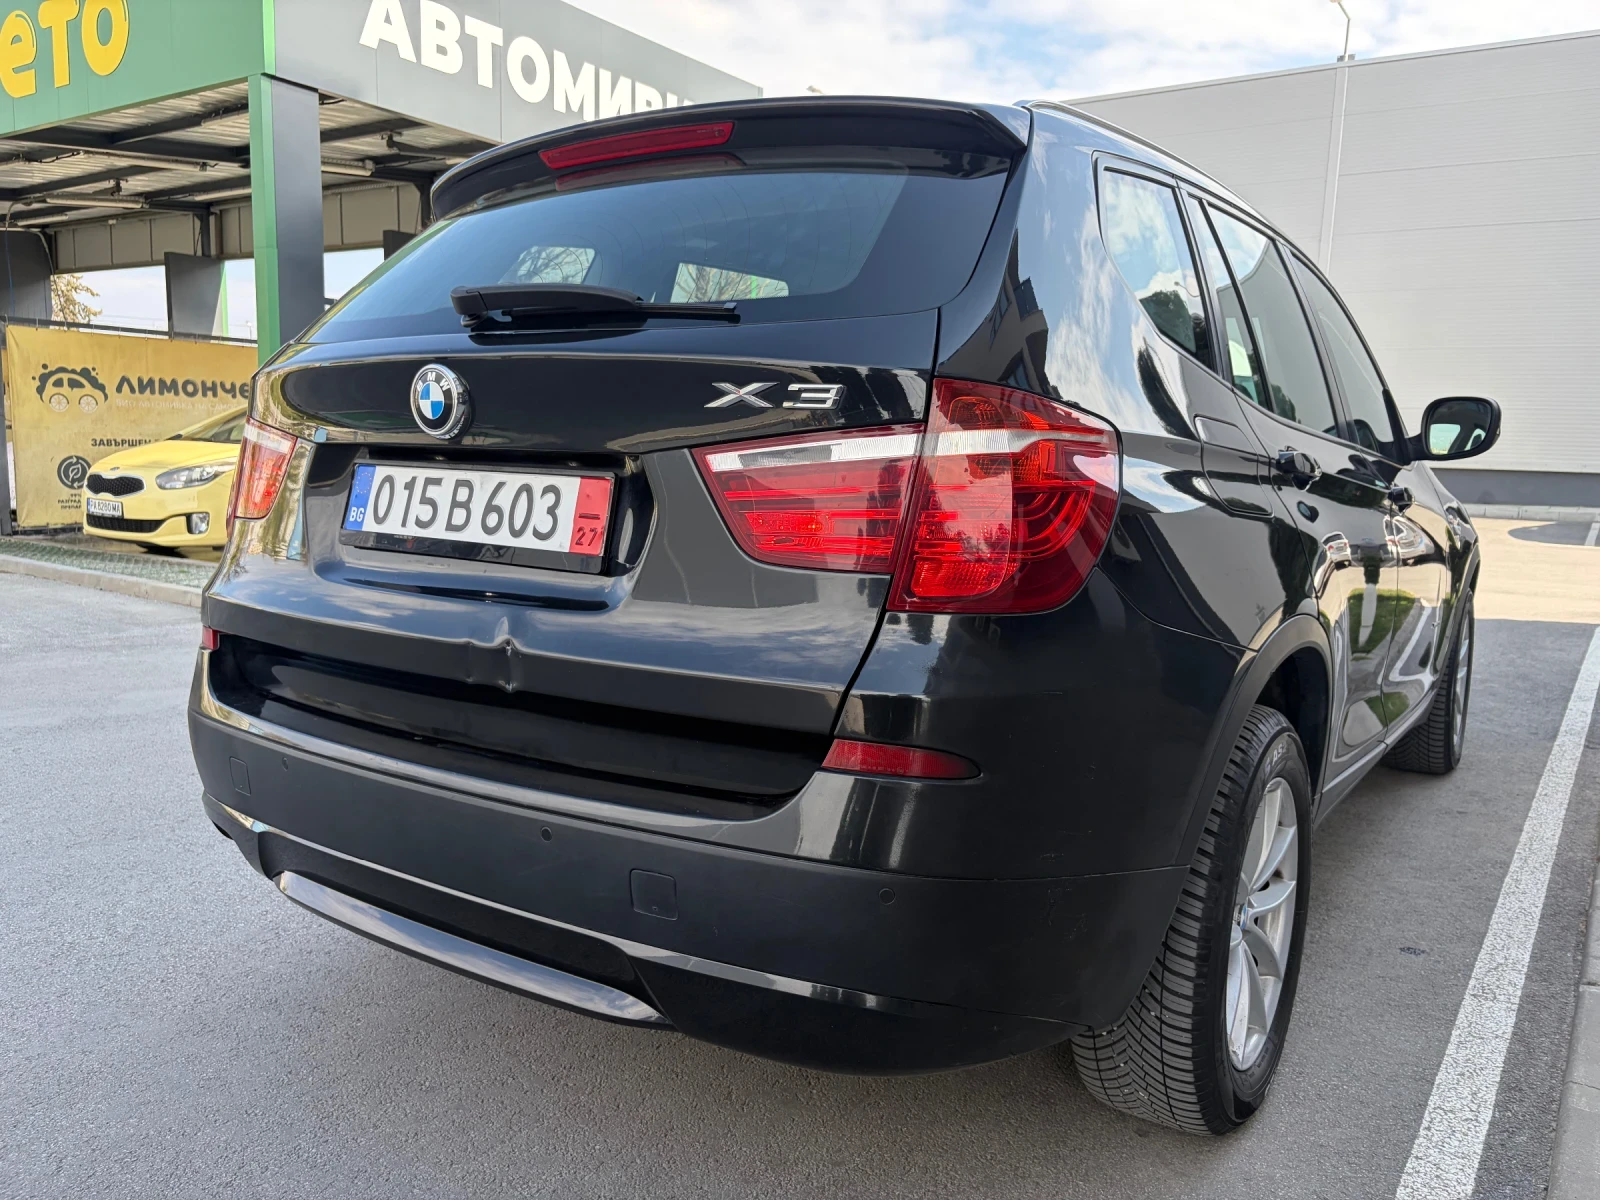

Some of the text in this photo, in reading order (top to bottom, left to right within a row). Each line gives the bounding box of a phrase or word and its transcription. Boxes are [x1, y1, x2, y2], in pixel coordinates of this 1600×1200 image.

[416, 371, 451, 391] BMW
[704, 382, 845, 410] X3
[349, 506, 364, 522] BG
[575, 526, 599, 547] 27
